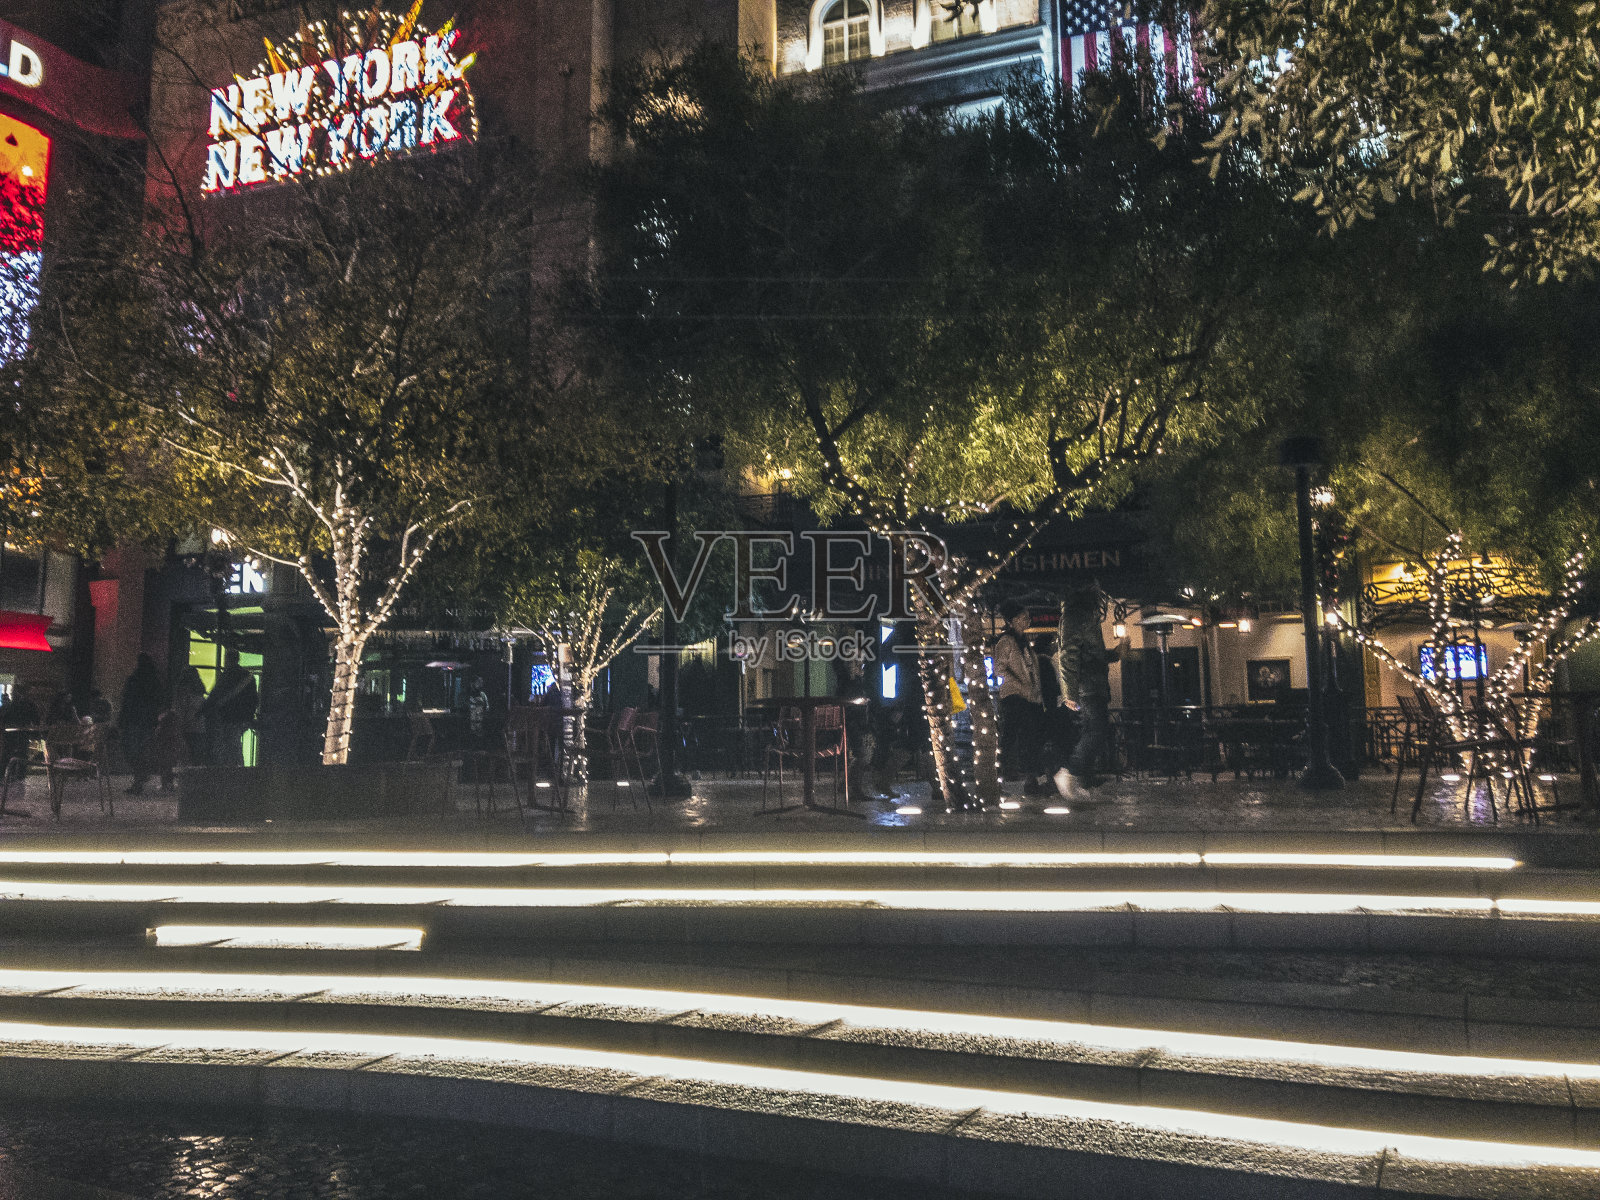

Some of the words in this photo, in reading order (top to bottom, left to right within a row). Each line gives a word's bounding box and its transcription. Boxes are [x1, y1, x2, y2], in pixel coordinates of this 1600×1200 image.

[208, 65, 316, 137] NEW
[322, 29, 462, 106] YORK
[205, 122, 312, 192] NEW
[320, 88, 462, 160] YORK
[1003, 550, 1121, 574] ISHMEN
